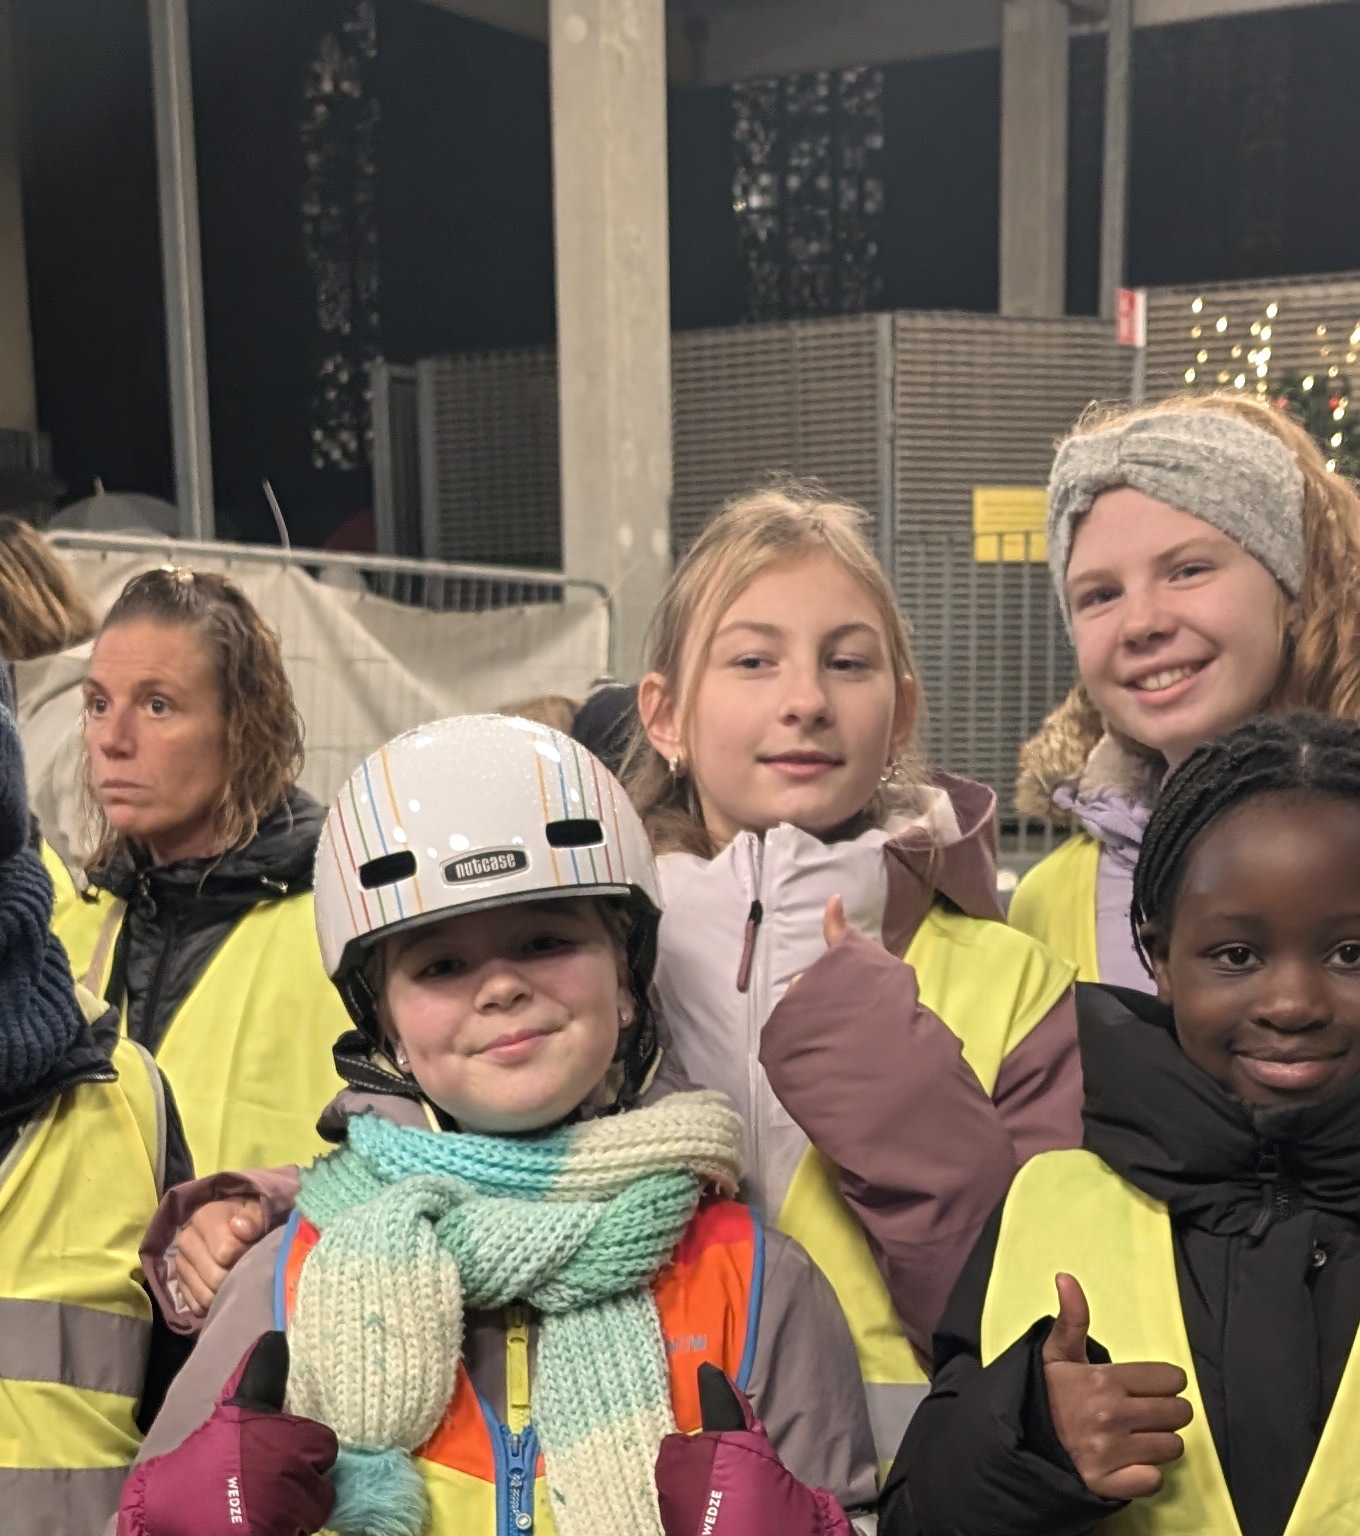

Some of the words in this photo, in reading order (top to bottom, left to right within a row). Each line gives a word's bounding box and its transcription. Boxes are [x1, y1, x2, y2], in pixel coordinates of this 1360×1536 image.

[455, 853, 517, 878] nutcase
[227, 1476, 243, 1524] WEDZE
[701, 1489, 723, 1536] WEDZE
